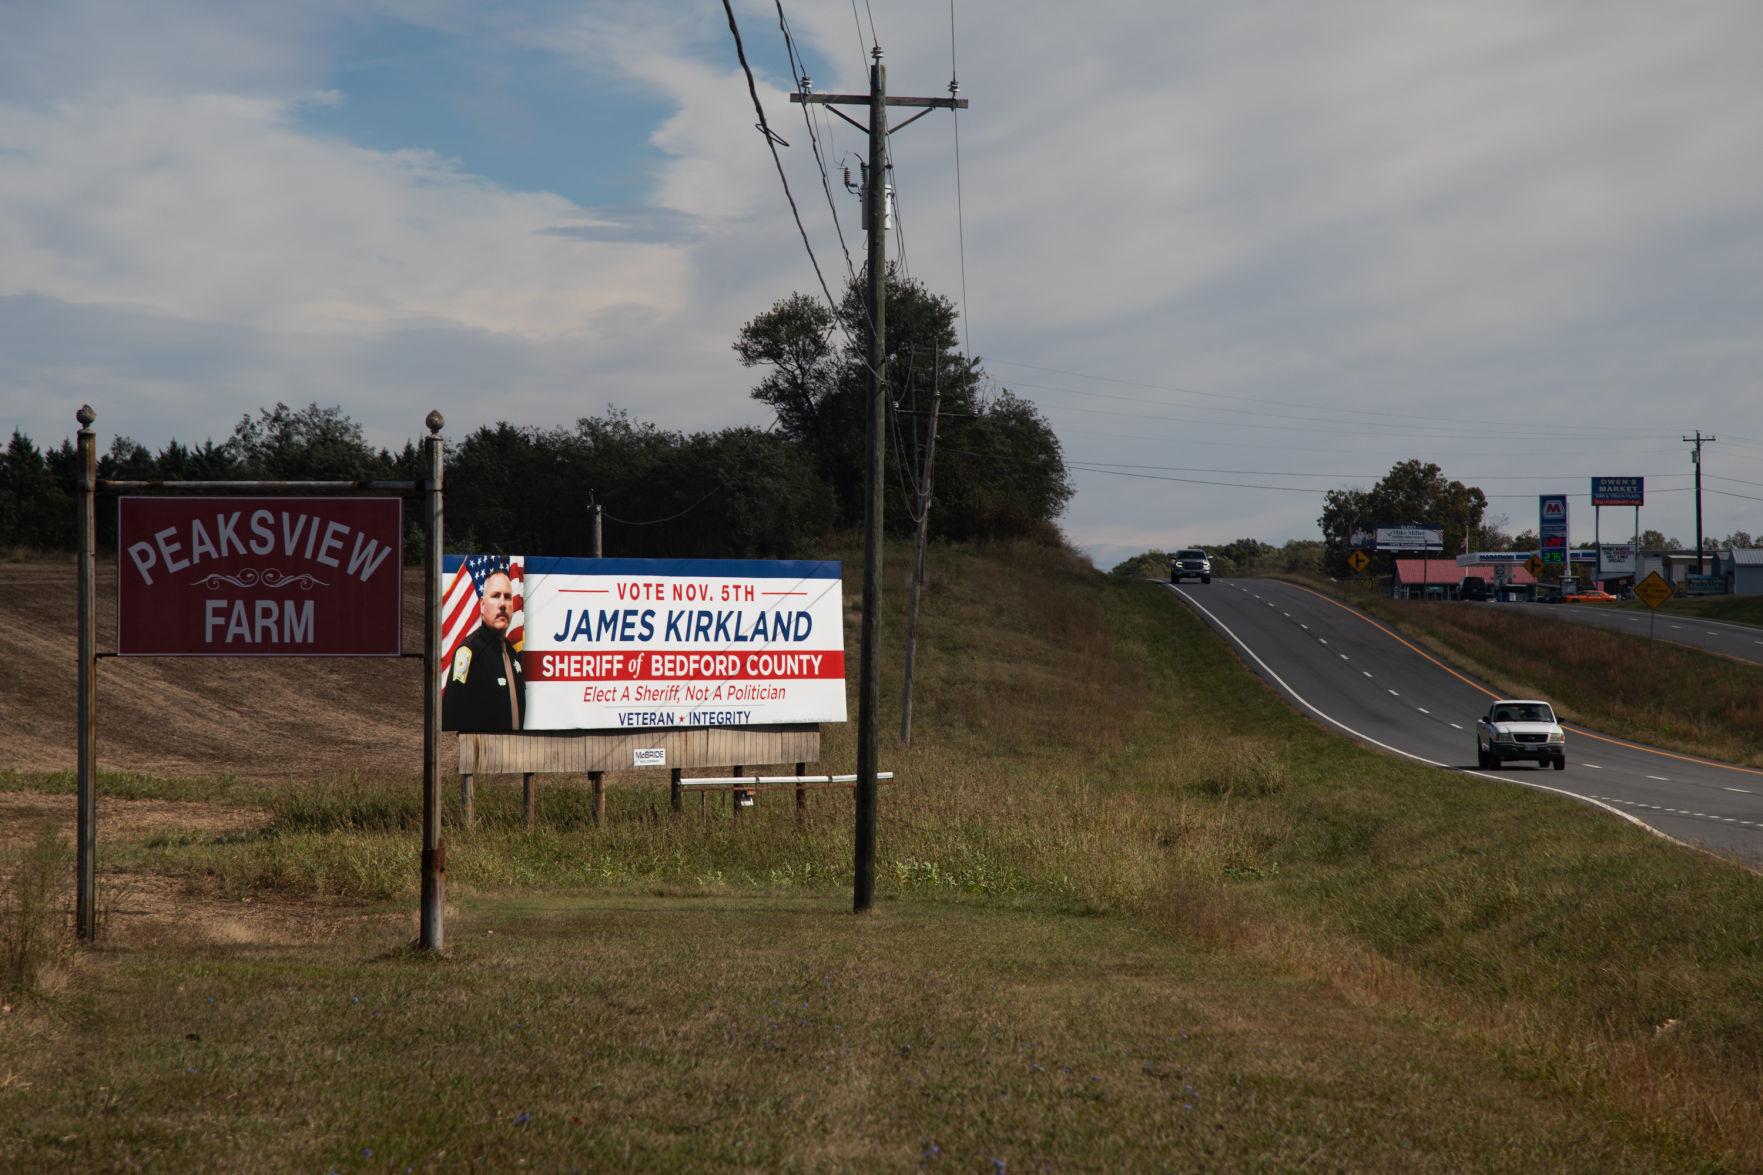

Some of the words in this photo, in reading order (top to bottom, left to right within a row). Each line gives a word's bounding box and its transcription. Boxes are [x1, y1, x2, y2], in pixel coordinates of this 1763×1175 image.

[1546, 503, 1561, 512] M
[128, 509, 393, 586] PEAKSVIEW
[618, 583, 665, 601] VOTE
[673, 583, 714, 602] NOV.
[722, 584, 755, 602] 5TH
[205, 600, 315, 643] FARM
[554, 609, 655, 642] JAMES
[665, 610, 813, 642] KIRKLAND
[542, 654, 624, 678] SHERIFF
[628, 652, 645, 679] of
[652, 654, 741, 676] BEDFORD
[746, 654, 823, 676] COUNTY
[583, 686, 618, 703] Elect
[620, 686, 631, 702] A
[634, 685, 681, 704] Sheriff,
[685, 685, 711, 702] Not
[712, 685, 723, 701] A
[726, 684, 787, 702] Politician
[619, 712, 675, 727] VETERAN
[688, 711, 752, 726] INTEGRITY
[635, 750, 664, 759] McBRIDE
